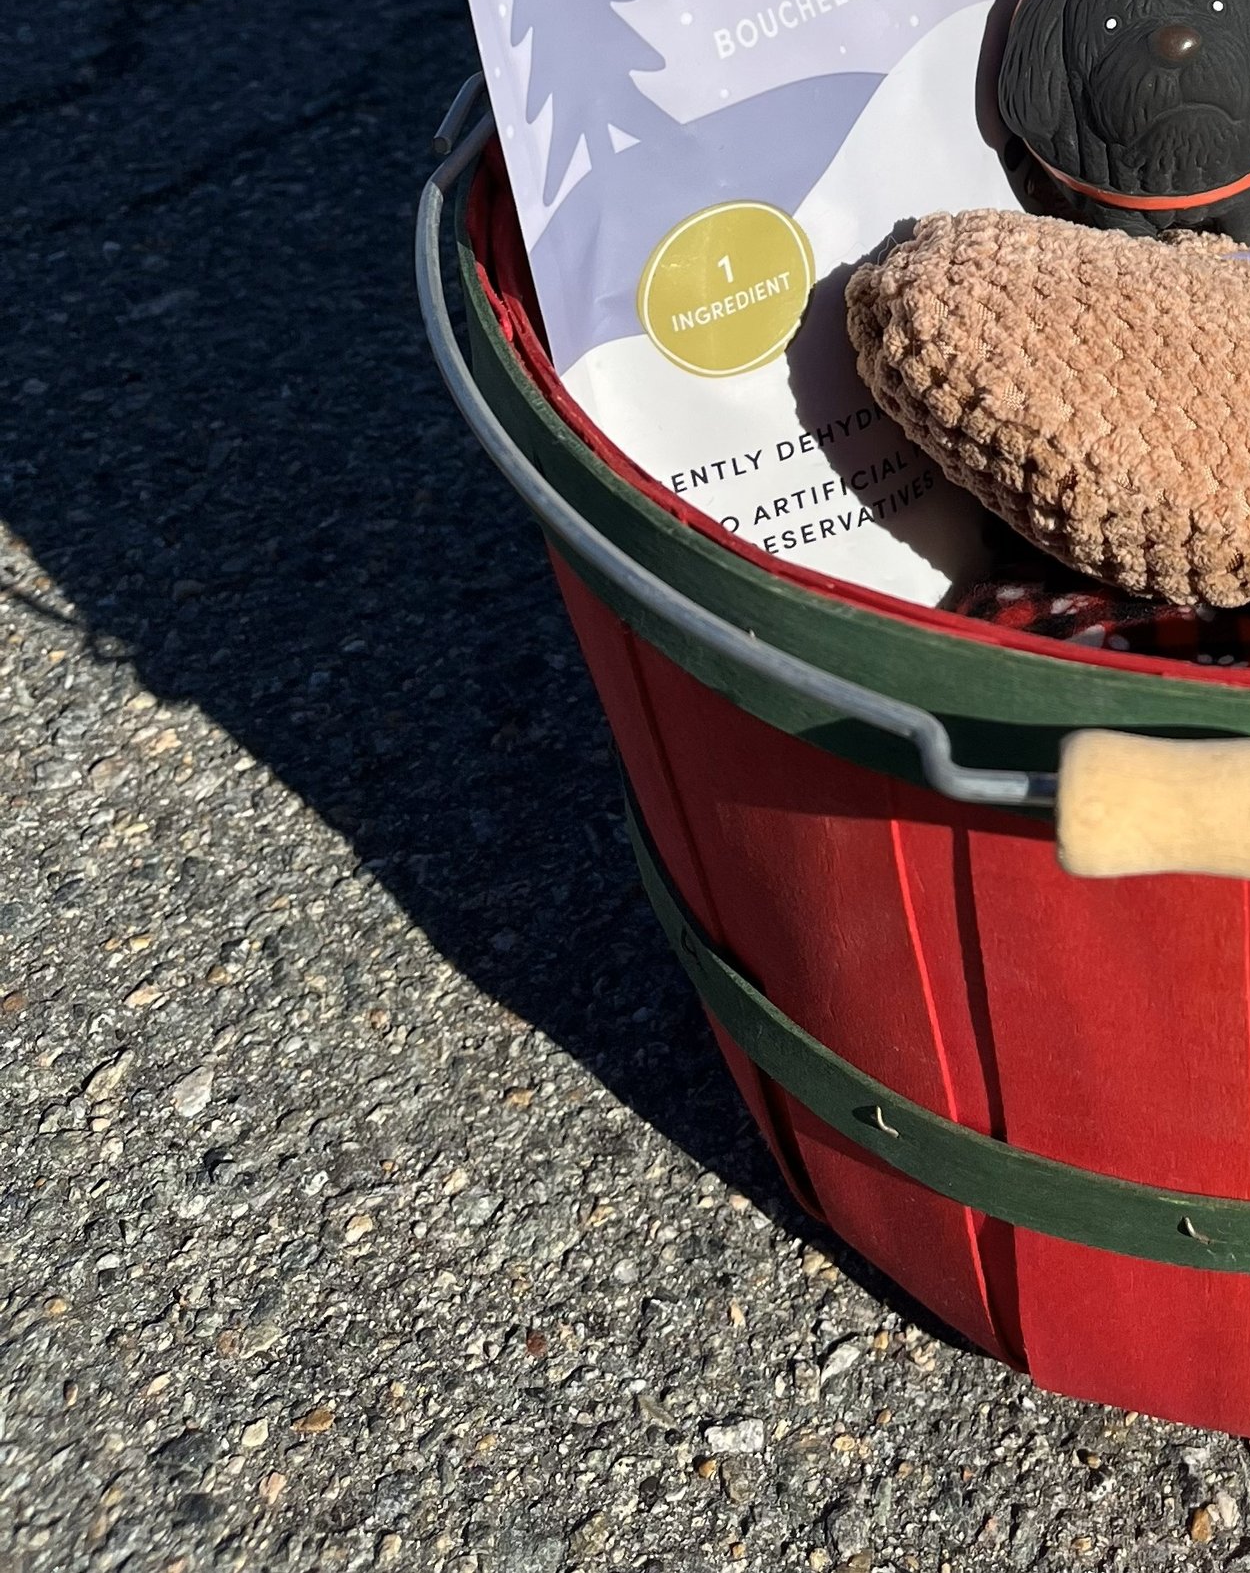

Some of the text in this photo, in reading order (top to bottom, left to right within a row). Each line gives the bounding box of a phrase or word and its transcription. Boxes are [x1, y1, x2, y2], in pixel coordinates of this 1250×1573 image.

[717, 255, 734, 283] 1
[671, 272, 791, 332] INGREDIENT
[671, 449, 762, 493] ENTLY
[754, 450, 908, 525] ARTIFICIAL
[763, 470, 934, 554] ESERVATIVES
